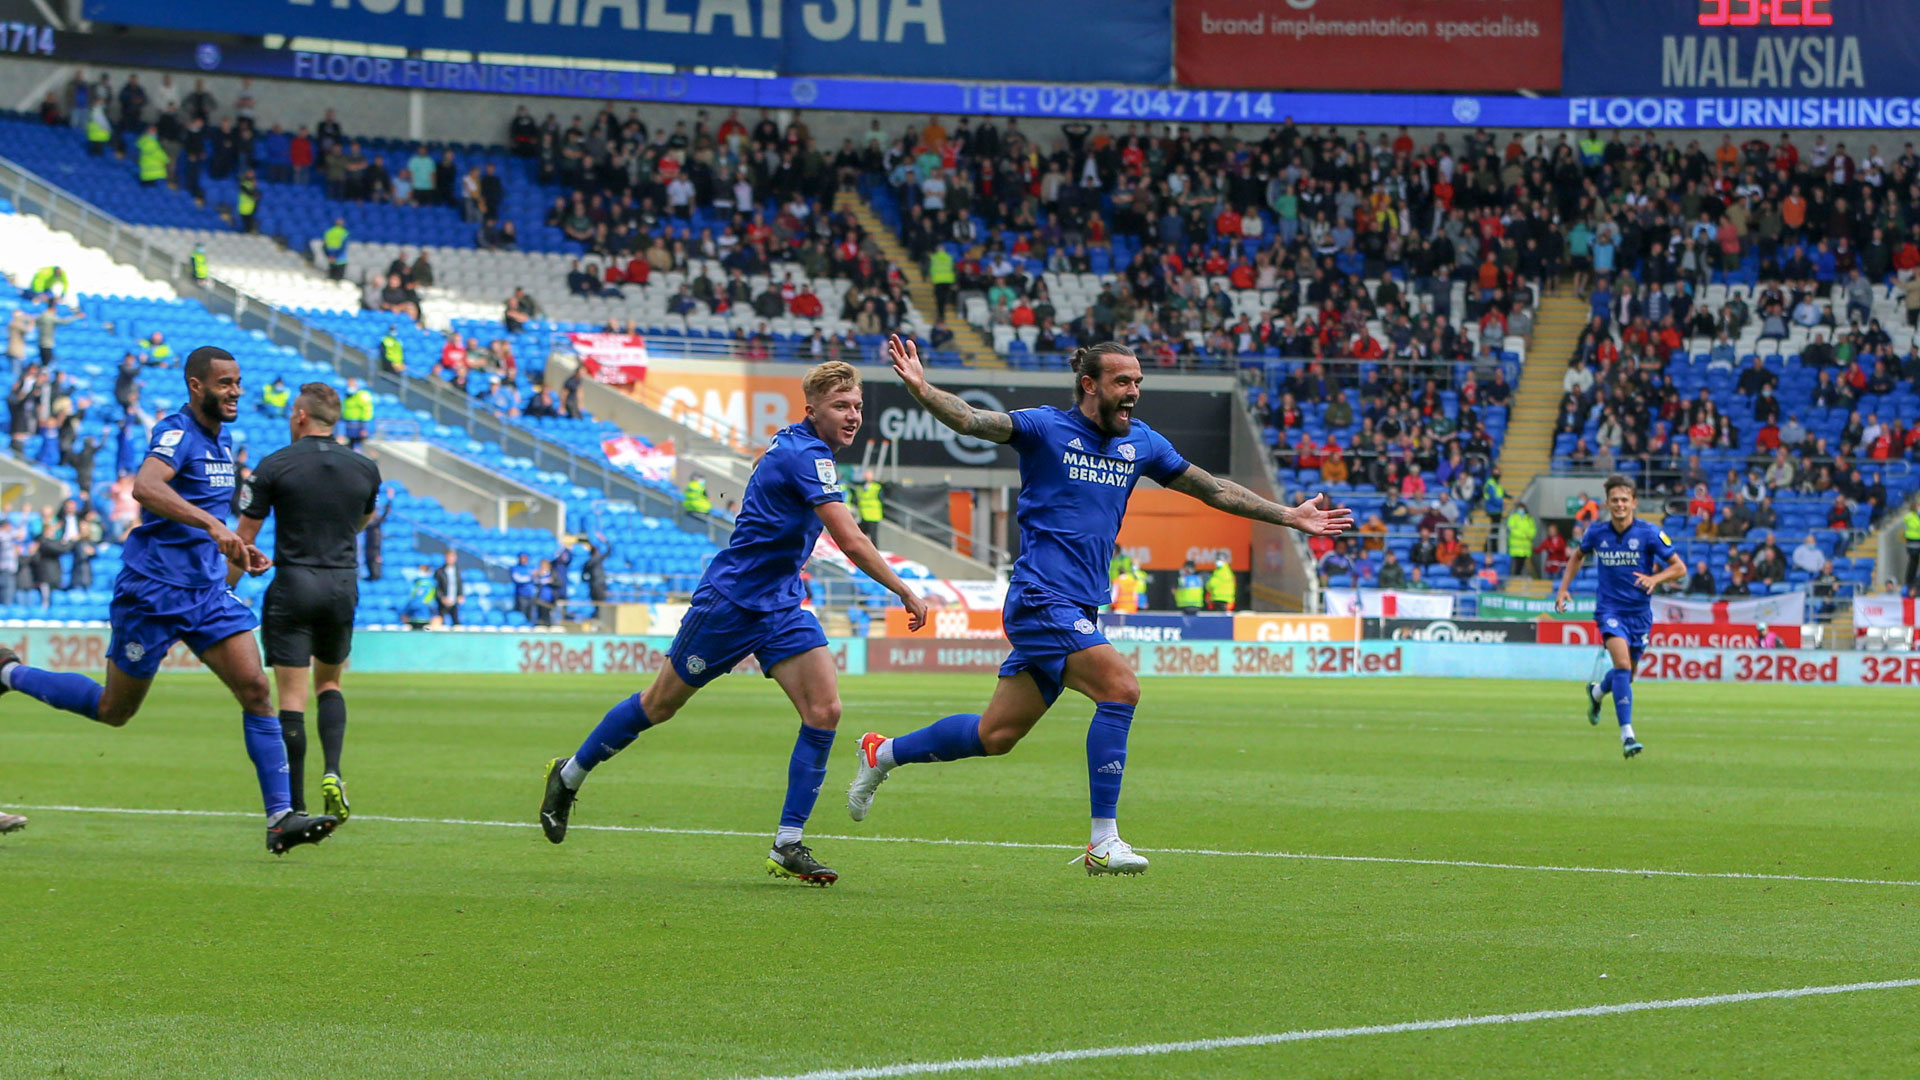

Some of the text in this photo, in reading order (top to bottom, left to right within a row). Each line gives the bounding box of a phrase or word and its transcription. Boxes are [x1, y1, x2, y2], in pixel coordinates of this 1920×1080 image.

[1202, 12, 1541, 42] brand implementation specialists
[294, 52, 689, 99] FLOOR FURNISHINGS LTD
[1662, 36, 1864, 88] MALAYSIA
[961, 84, 1275, 118] TEL: 029 20471714
[1569, 98, 1685, 127] FLOOR
[1063, 452, 1135, 475] MALAYSIA
[1069, 467, 1128, 488] BERJAYA
[1257, 622, 1331, 641] GMB
[518, 640, 665, 673] 32Red 32Re
[890, 648, 926, 666] PLAY
[1154, 646, 1219, 672] 32Red
[1232, 646, 1294, 672] 32Red
[1306, 646, 1403, 673] 32Red
[1639, 652, 1722, 680] 2Red
[1735, 655, 1838, 683] 32Red
